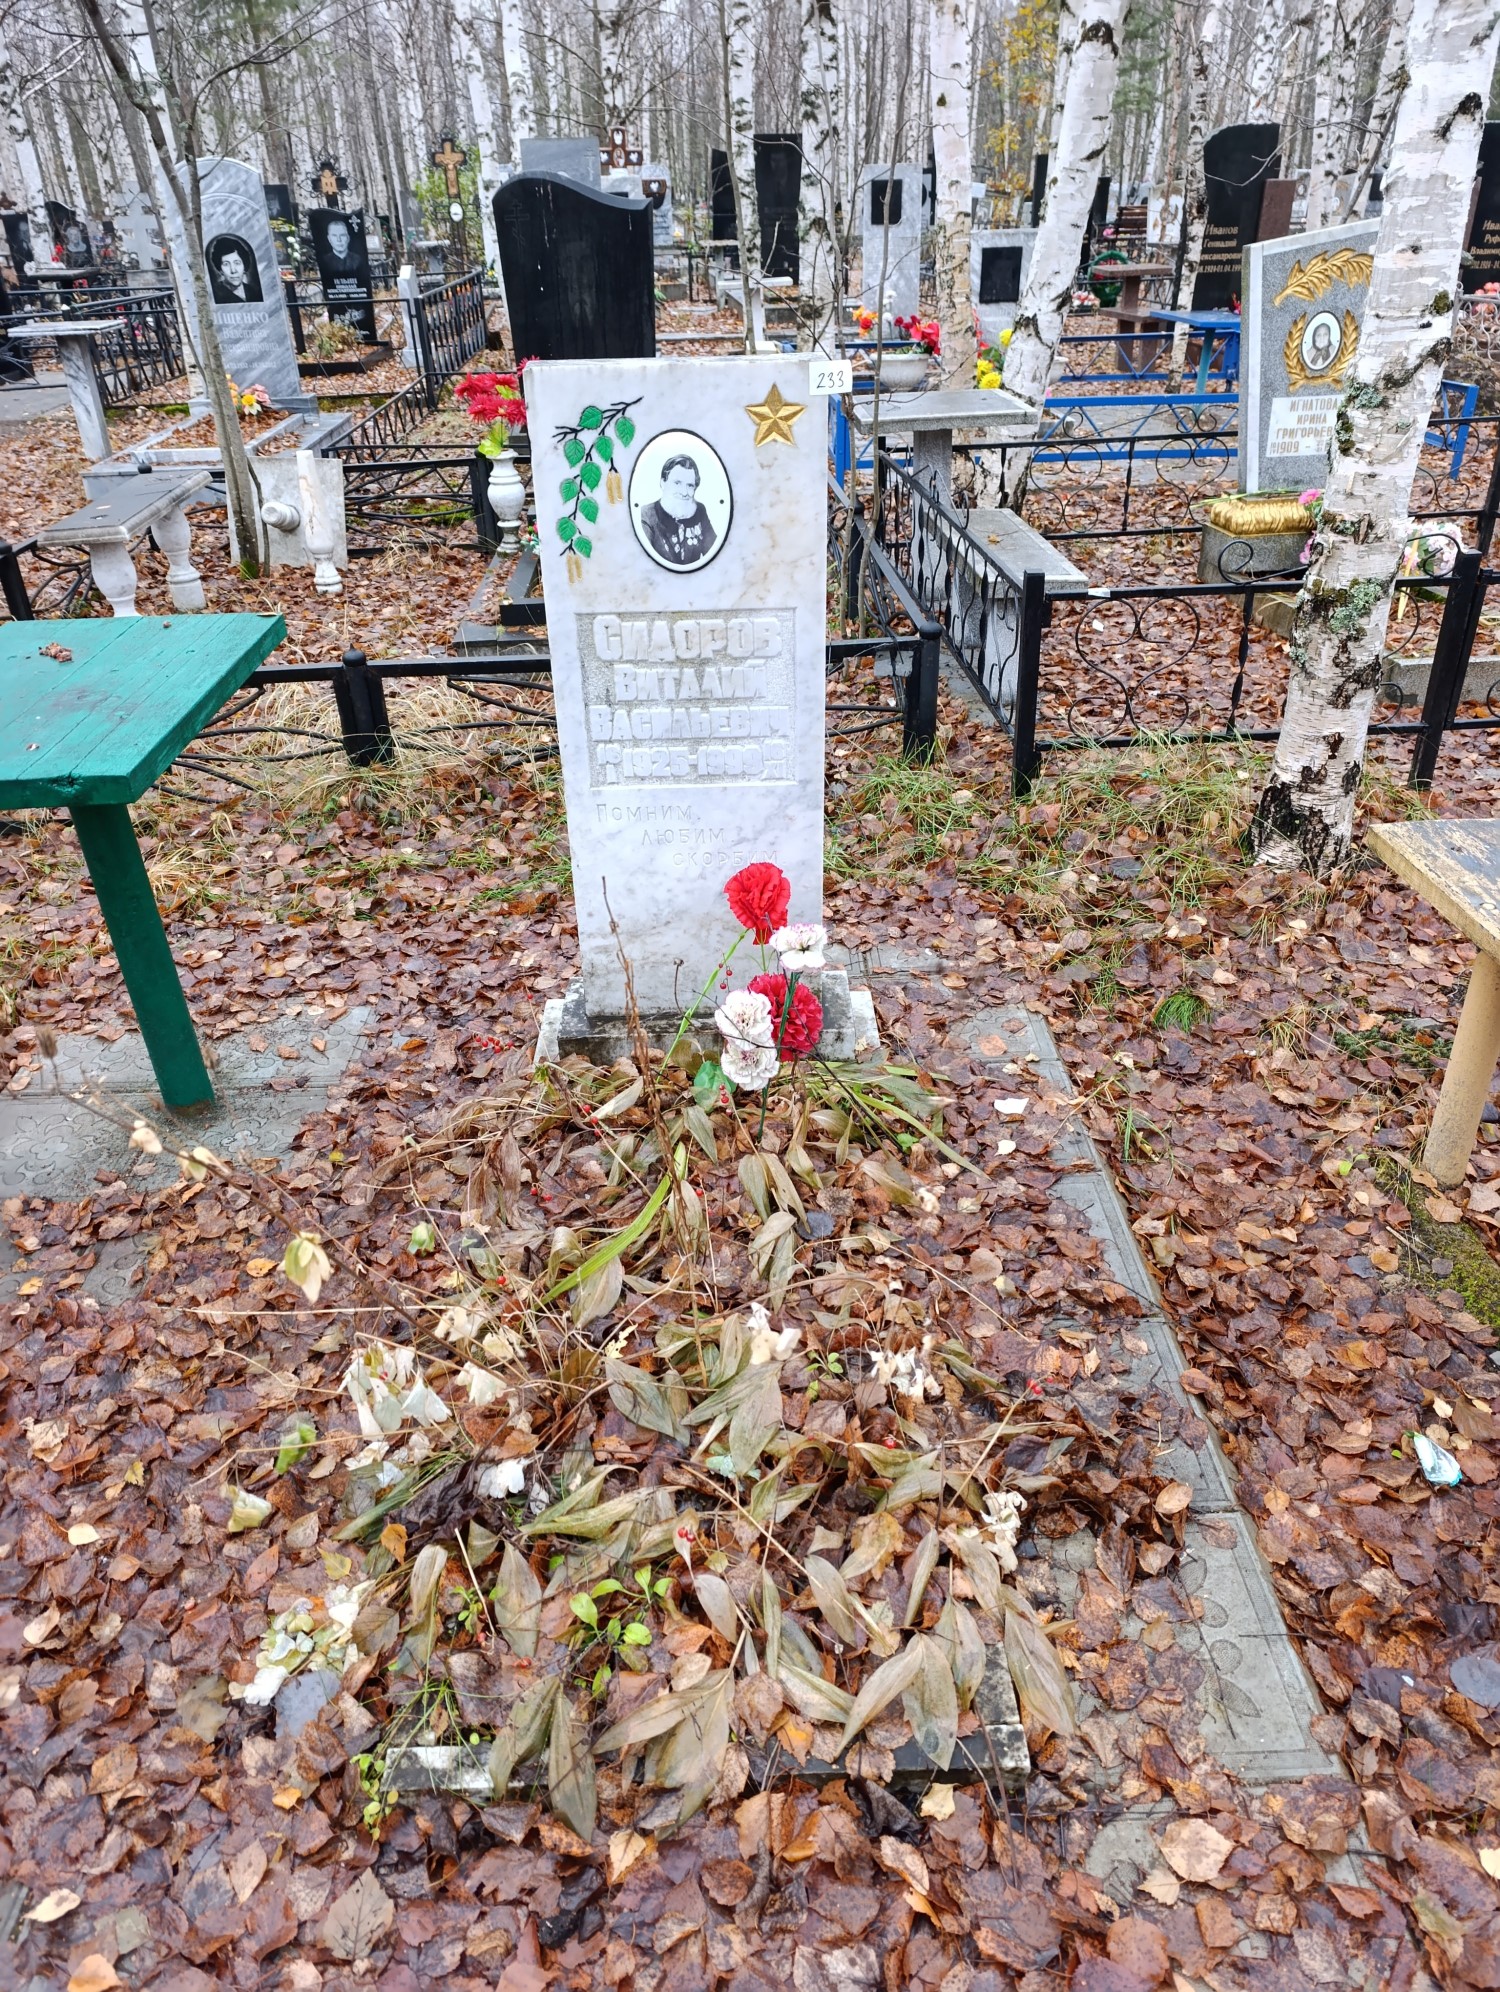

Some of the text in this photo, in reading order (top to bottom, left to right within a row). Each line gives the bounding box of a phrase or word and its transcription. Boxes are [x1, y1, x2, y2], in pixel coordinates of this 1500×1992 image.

[1206, 224, 1239, 235] Иванов
[816, 370, 845, 389] 233
[1289, 398, 1338, 412] ИГНАТОВА
[1296, 413, 1328, 425] ИРИНА
[593, 615, 783, 662] СИДОРОВ
[613, 659, 767, 702] ВИТАЛИЙ
[588, 705, 791, 742] ВАСИЛЬЕВИЧ
